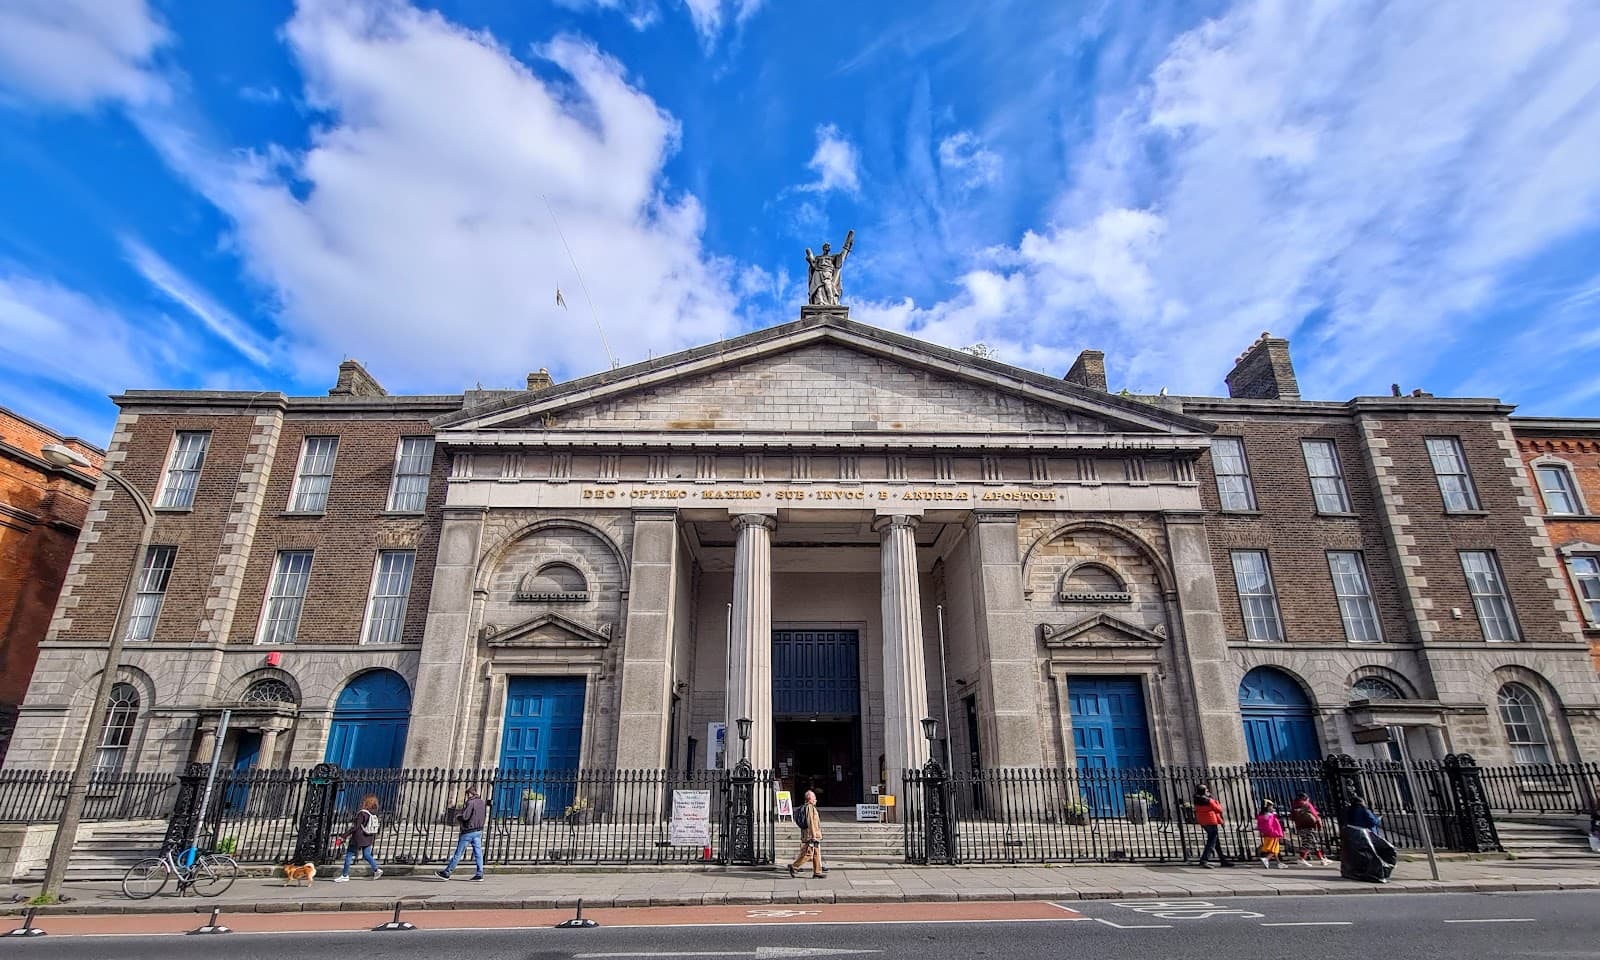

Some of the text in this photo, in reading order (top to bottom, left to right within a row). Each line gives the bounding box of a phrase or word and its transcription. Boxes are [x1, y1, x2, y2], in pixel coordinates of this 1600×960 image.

[583, 489, 615, 499] DEO
[630, 490, 687, 499] OPTIMO
[702, 490, 762, 500] MAXIMO
[774, 490, 805, 500] SUB
[816, 490, 864, 500] INVOC
[982, 490, 1056, 501] APOSTOLI
